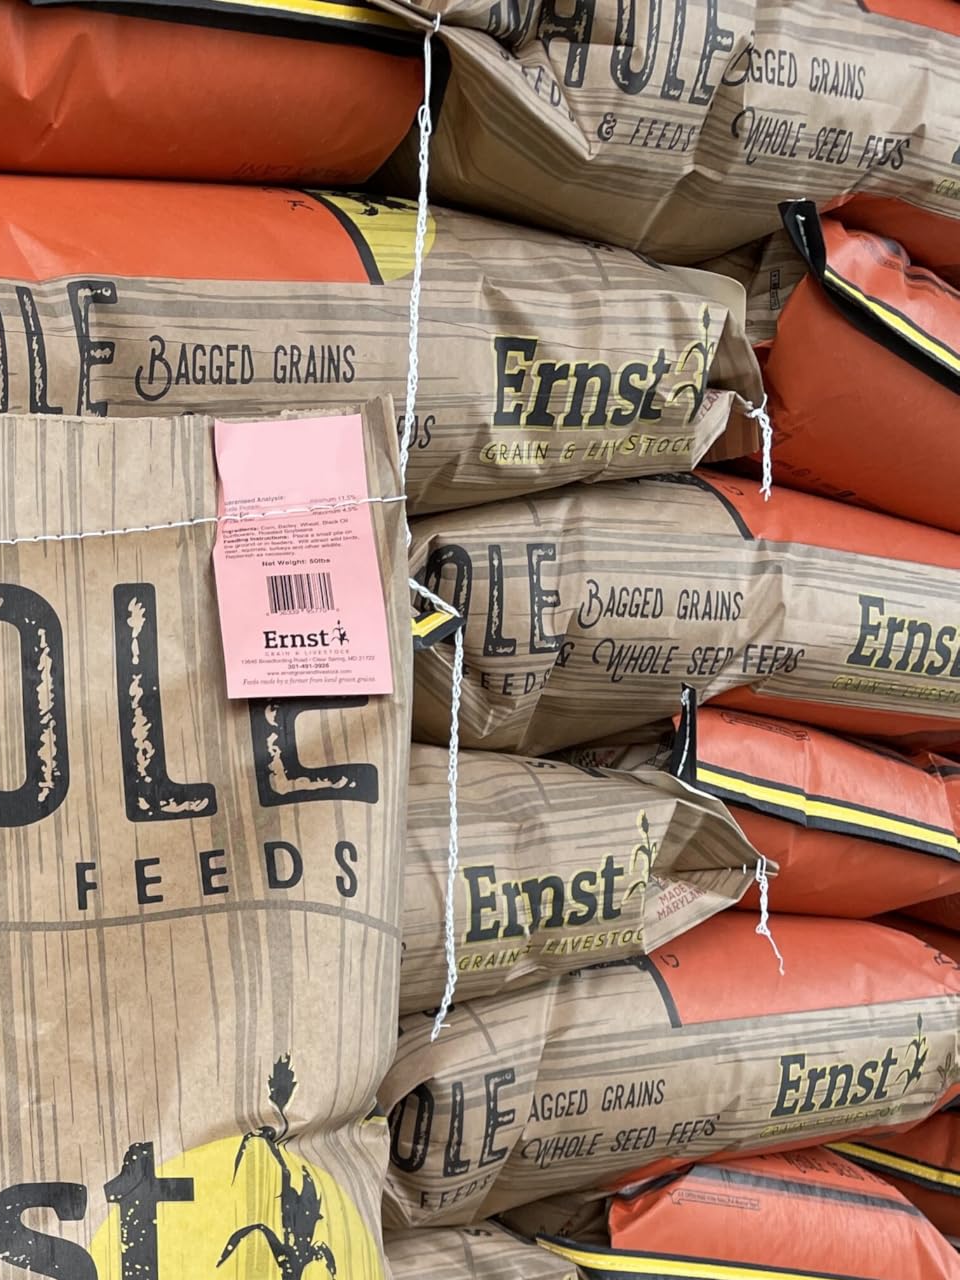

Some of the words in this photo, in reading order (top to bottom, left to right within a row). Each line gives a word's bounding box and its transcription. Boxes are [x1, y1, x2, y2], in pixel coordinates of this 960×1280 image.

[809, 57, 866, 101] GRAINS
[597, 112, 617, 141] &
[629, 118, 697, 153] FEEDS
[731, 106, 806, 166] WHOLE
[807, 126, 854, 164] SEED
[135, 335, 255, 401] BAGGED
[273, 344, 356, 385] GRAINS
[492, 333, 672, 432] Ernst
[480, 439, 551, 465] GRAIN
[577, 578, 665, 630] BAGGED
[676, 588, 744, 622] GRAINS
[263, 629, 330, 649] Ernst
[592, 637, 680, 683] WHOLE
[686, 646, 735, 677] SEED
[75, 840, 358, 911] FEEDS
[658, 884, 688, 906] MADE
[459, 854, 628, 947] Ernst
[457, 951, 520, 973] GRAIN
[528, 1089, 589, 1123] AGGED
[601, 1079, 666, 1113] GRAINS
[769, 1046, 898, 1119] Ernst
[521, 1133, 604, 1170] WHOLE
[610, 1126, 657, 1153] SEED
